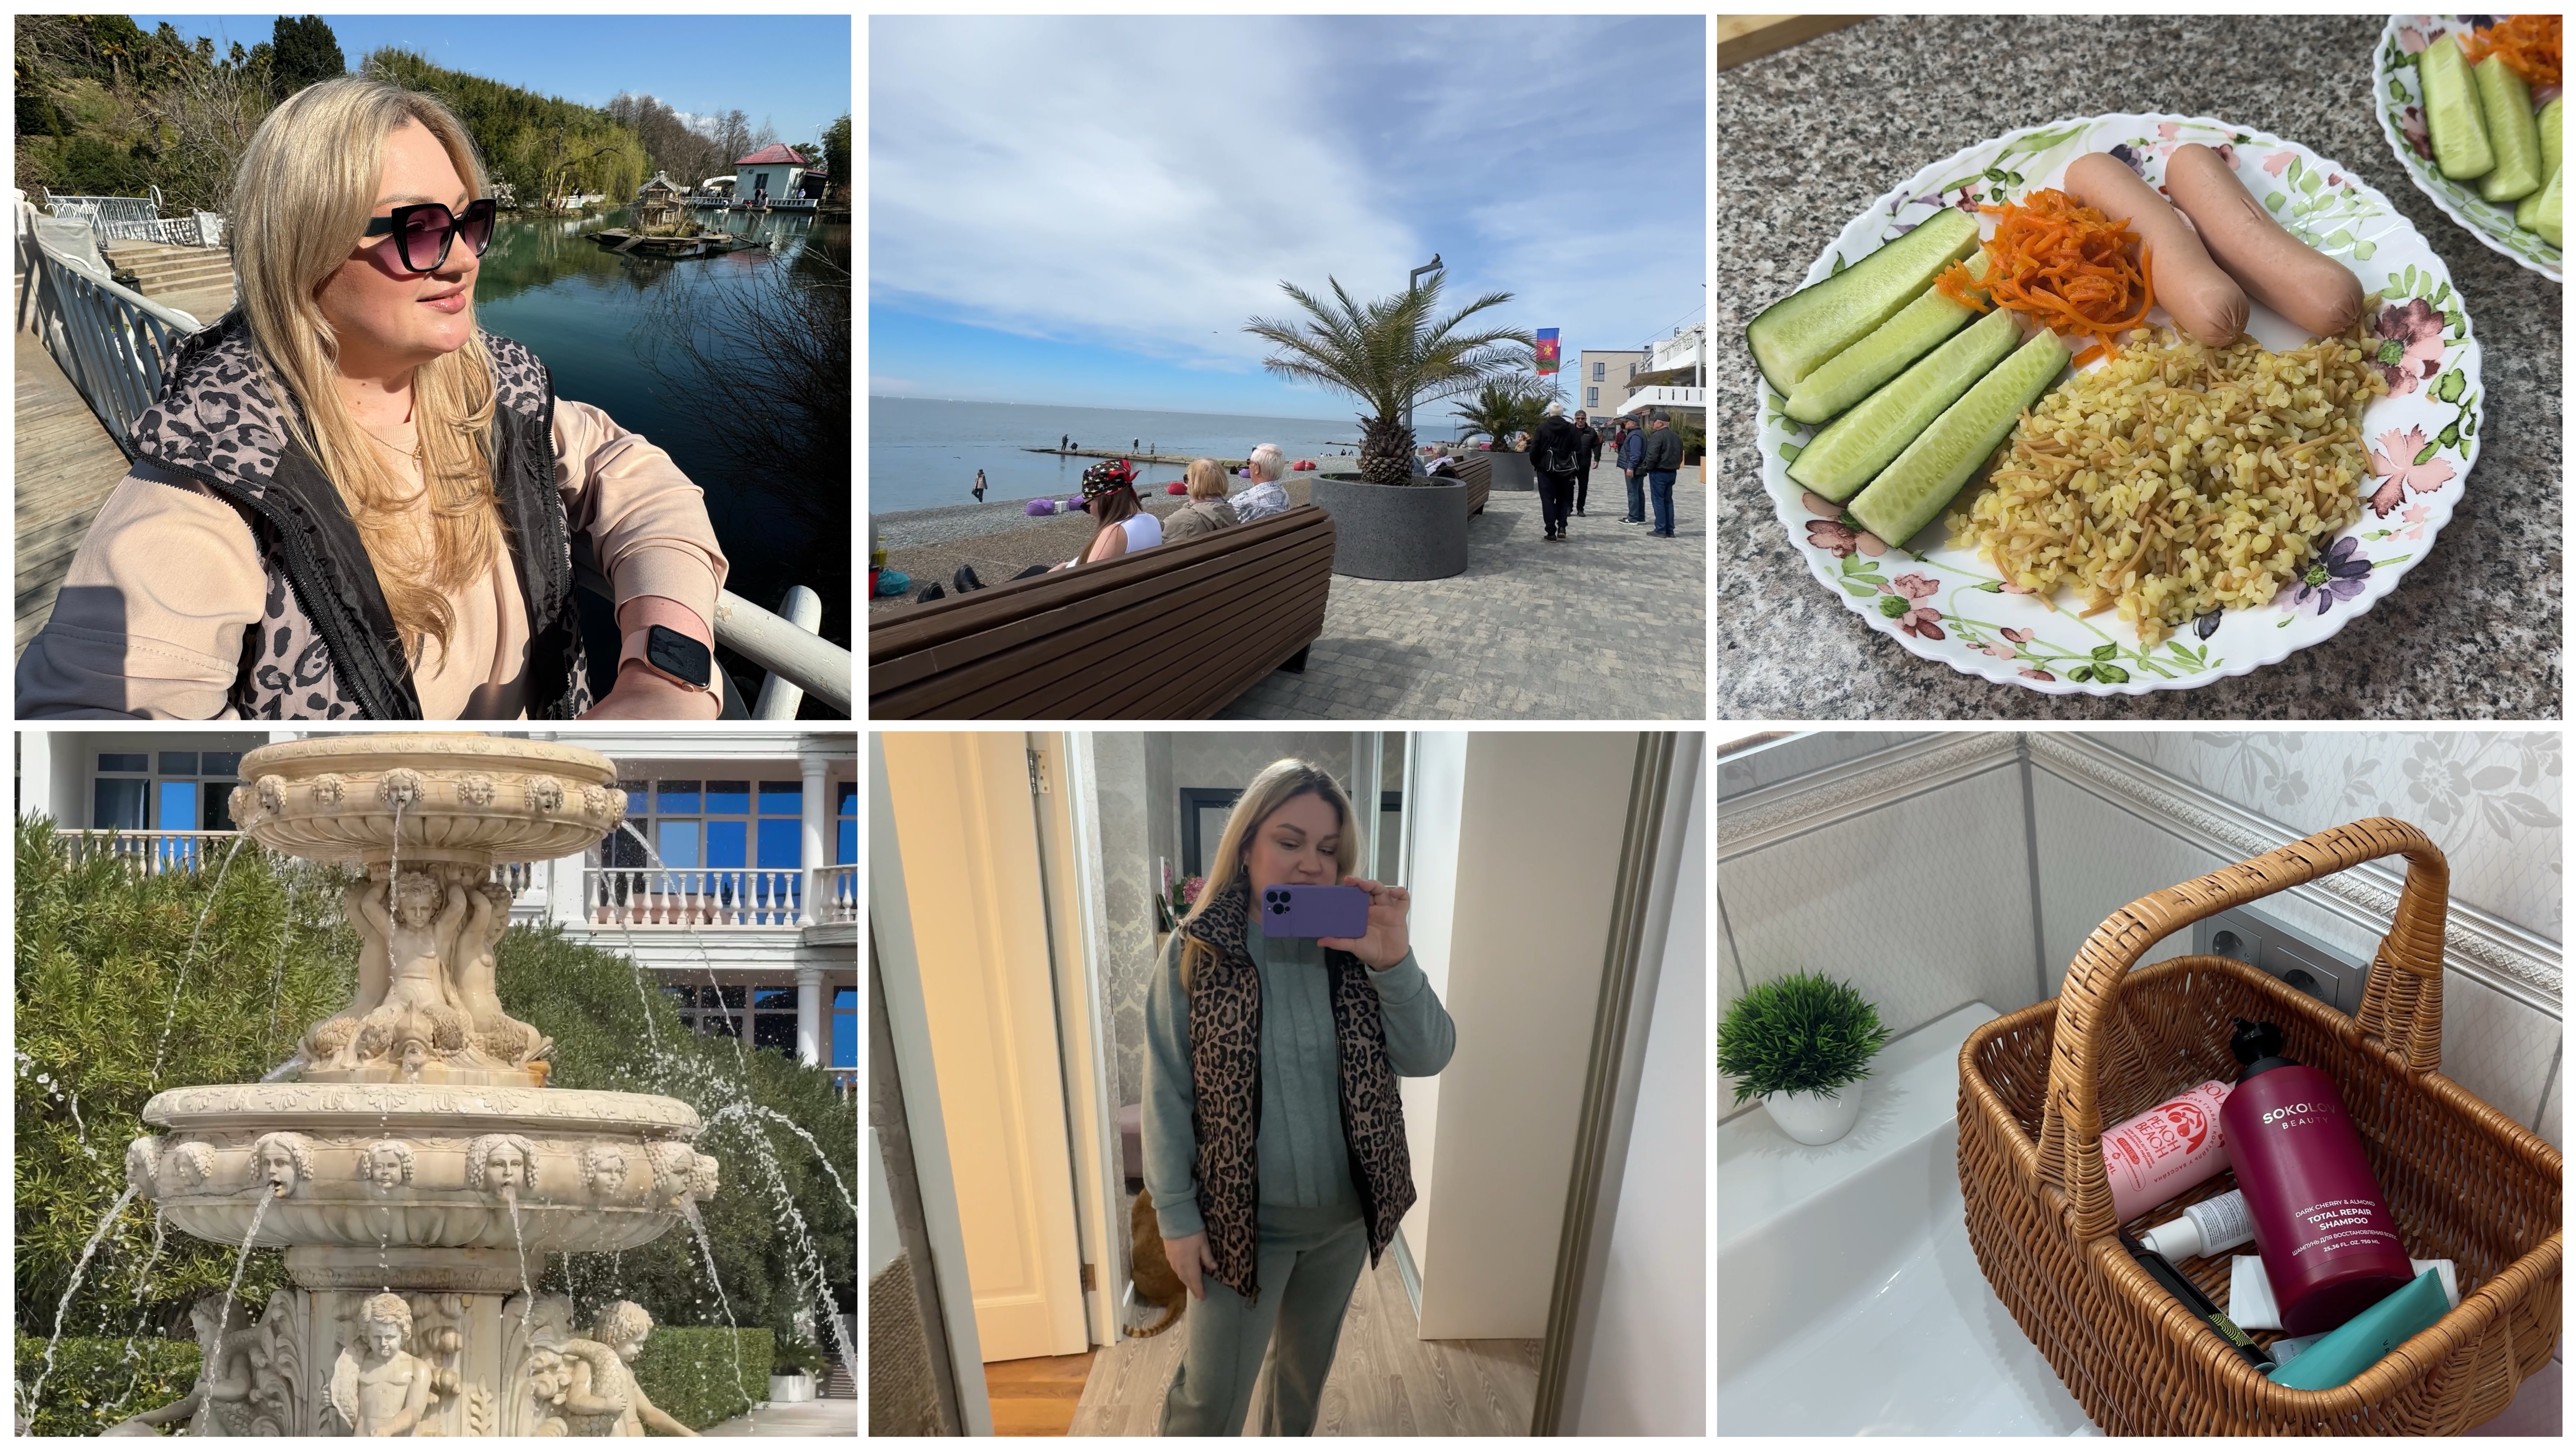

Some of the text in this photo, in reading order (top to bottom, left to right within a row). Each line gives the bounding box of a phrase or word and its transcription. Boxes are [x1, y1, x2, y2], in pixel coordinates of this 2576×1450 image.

[686, 657, 695, 678] 13:57
[2203, 1103, 2217, 1122] ГУАВА
[2263, 1102, 2335, 1124] SOKOLOV
[2282, 1117, 2328, 1129] BEAUTY
[2135, 1122, 2169, 1158] BEACH
[2147, 1116, 2181, 1152] PEACH
[2123, 1131, 2141, 1150] экстрактом
[2140, 1150, 2152, 1169] персика
[2195, 1130, 2217, 1161] КОКТЕЙЛЬ
[2146, 1152, 2155, 1164] душа
[2107, 1163, 2116, 1175] ML
[2154, 1163, 2187, 1183] БАССЕЙНА
[2295, 1206, 2314, 1218] DARK
[2315, 1200, 2342, 1210] CHERRY
[2307, 1211, 2339, 1224] TOTAL
[2319, 1217, 2368, 1230] SHAMPOO
[2292, 1230, 2398, 1256] ШАМПУНЬ ДЛЯ ВОССТАНОВЛЕНИЯ ВОЛОС
[2323, 1243, 2339, 1252] 25,36
